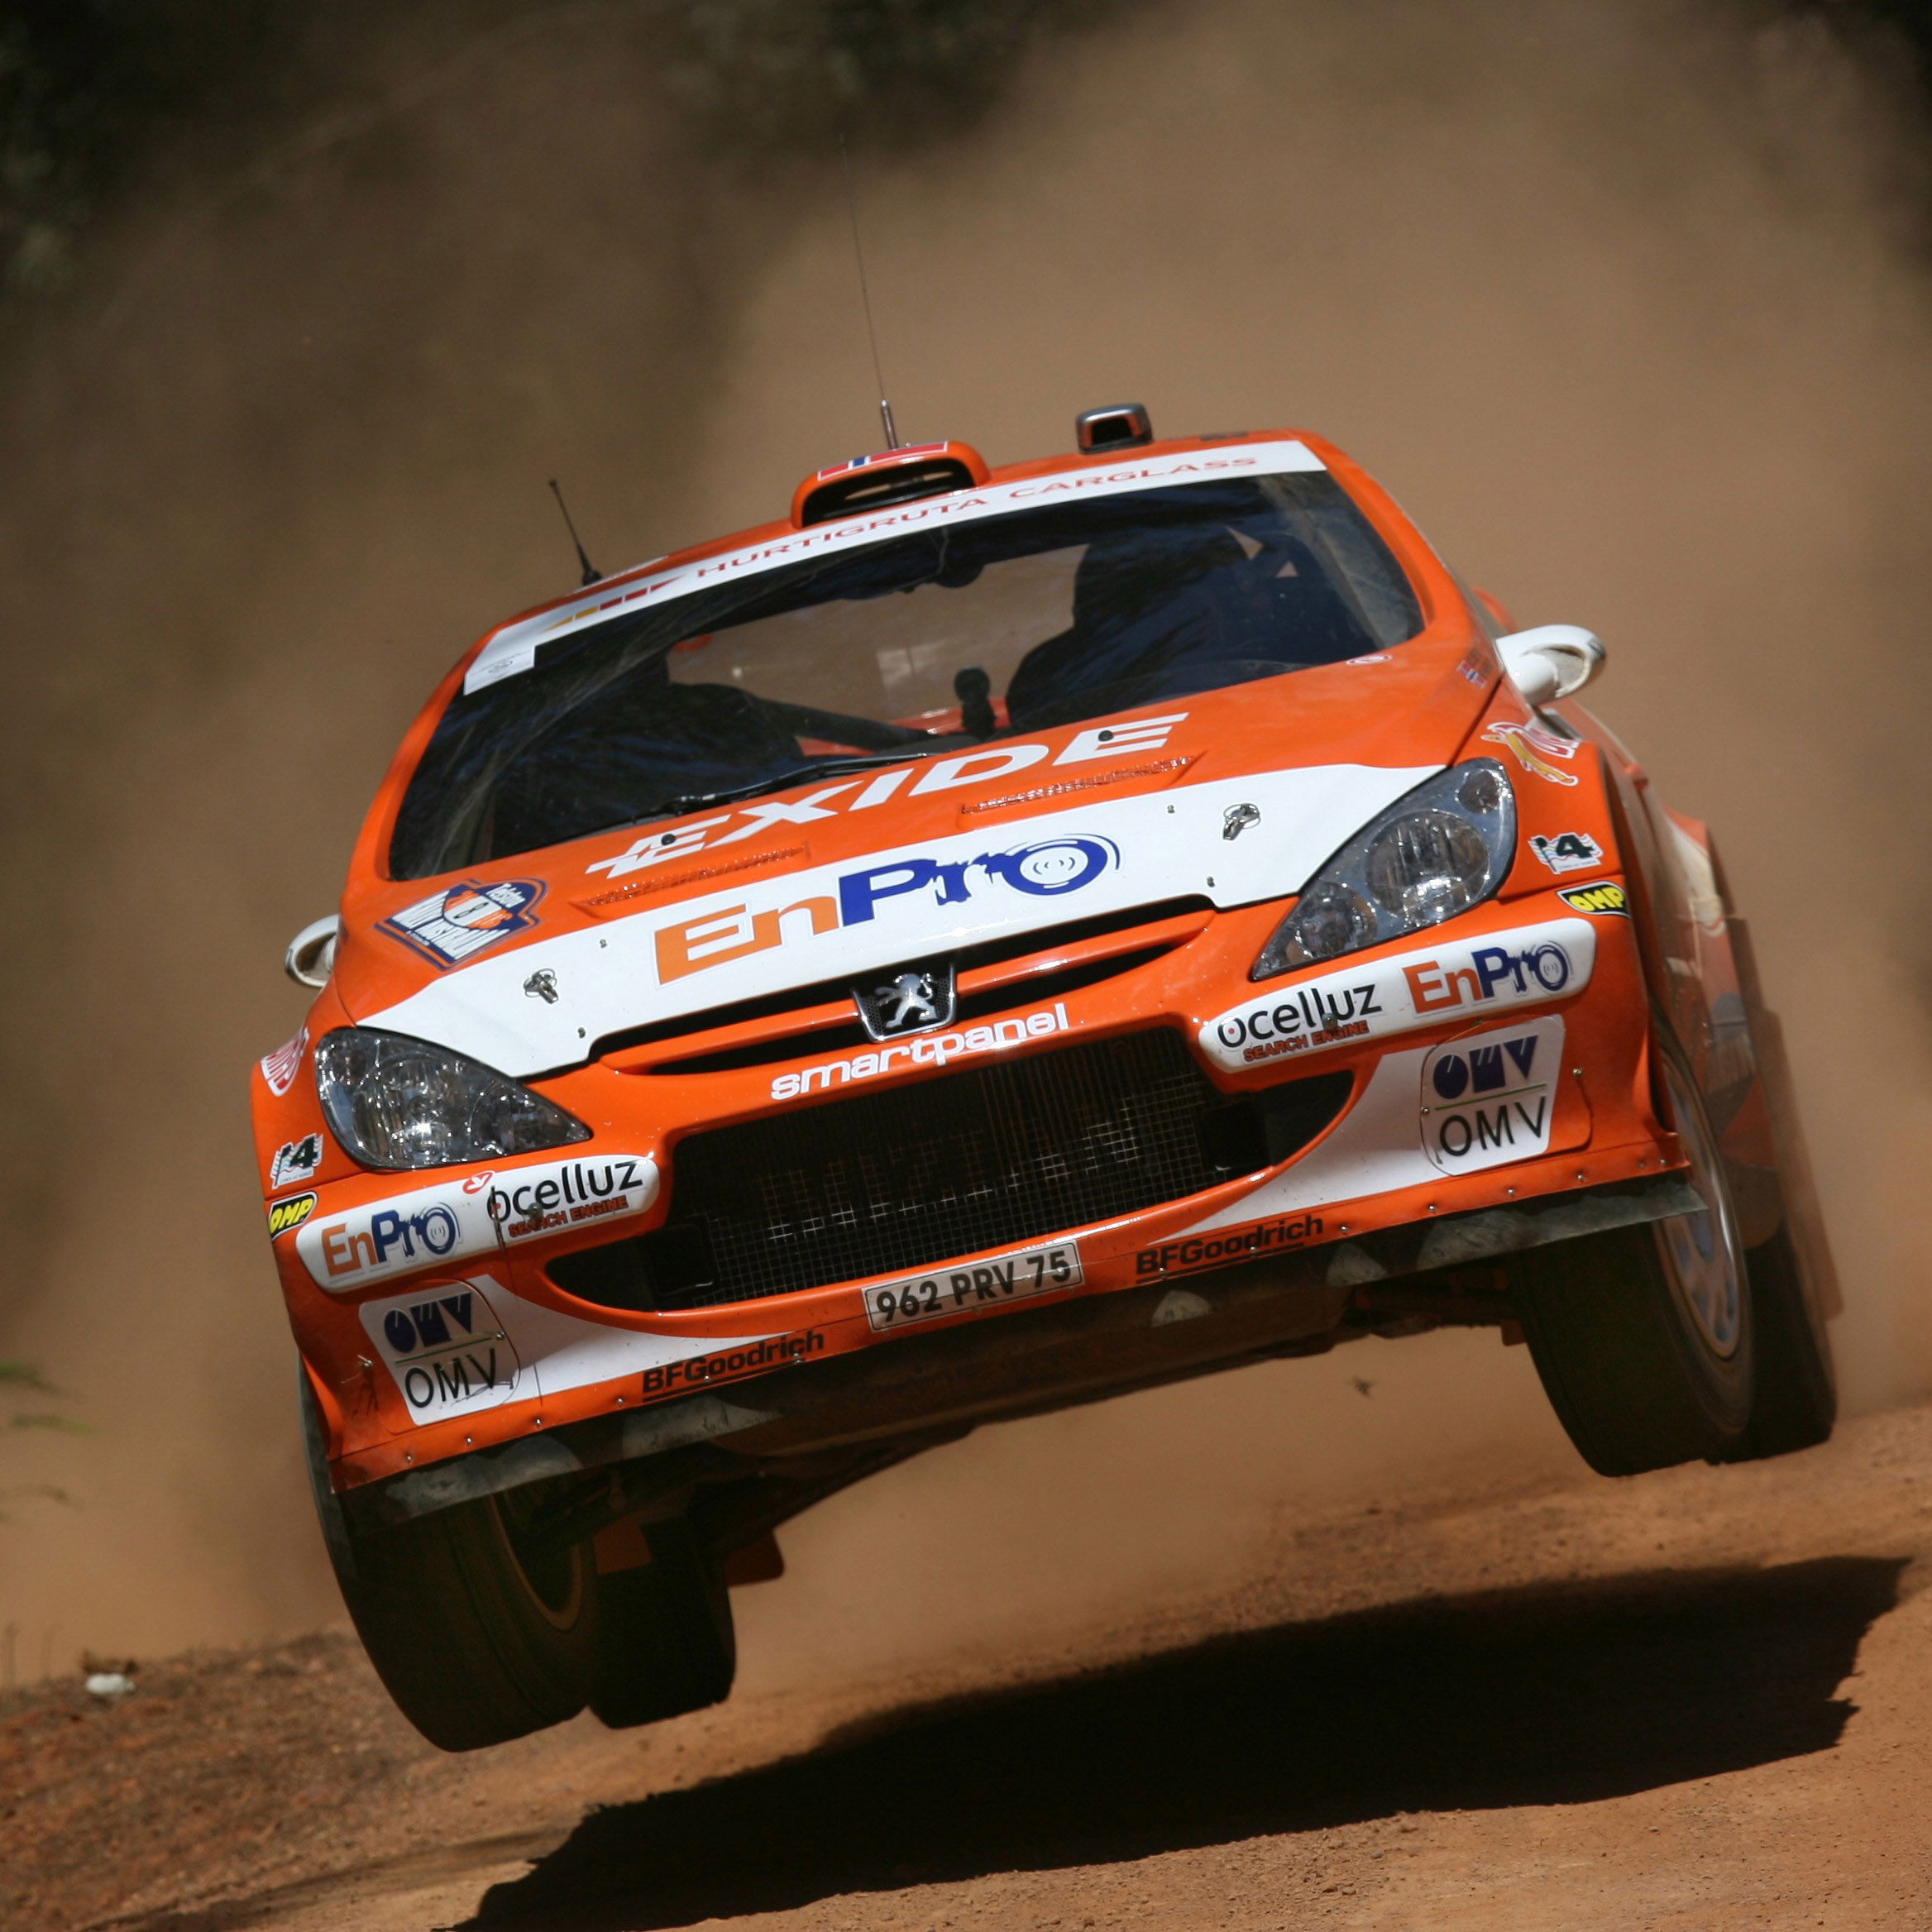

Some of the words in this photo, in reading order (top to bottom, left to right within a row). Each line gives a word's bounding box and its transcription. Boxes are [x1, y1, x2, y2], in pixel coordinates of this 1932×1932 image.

[698, 498, 988, 578] HURTIGRUTA
[1008, 457, 1257, 498] CARGLASS
[586, 712, 1189, 879] EXIDE
[654, 833, 1121, 986] EnPro
[1568, 886, 1625, 912] OMP
[1401, 940, 1574, 1014] EnPro
[1217, 984, 1383, 1048] ocelluz
[1243, 1034, 1310, 1062] SEARCH
[1312, 1020, 1370, 1045] ENGINE
[771, 1002, 1069, 1101] smartpanel
[1439, 1096, 1547, 1156] OMV
[269, 1198, 314, 1235] OMP
[486, 1161, 643, 1222] ocelluz
[508, 1210, 568, 1238] SEARCH
[569, 1195, 629, 1222] ENGINE
[321, 1202, 461, 1278] EnPro
[1135, 1214, 1324, 1276] BFGoodrich
[875, 1281, 944, 1322] 962
[953, 1261, 1017, 1307] PRV
[1026, 1250, 1072, 1289] 75
[404, 1348, 496, 1408] OMV
[642, 1330, 824, 1394] BFGoodrich
